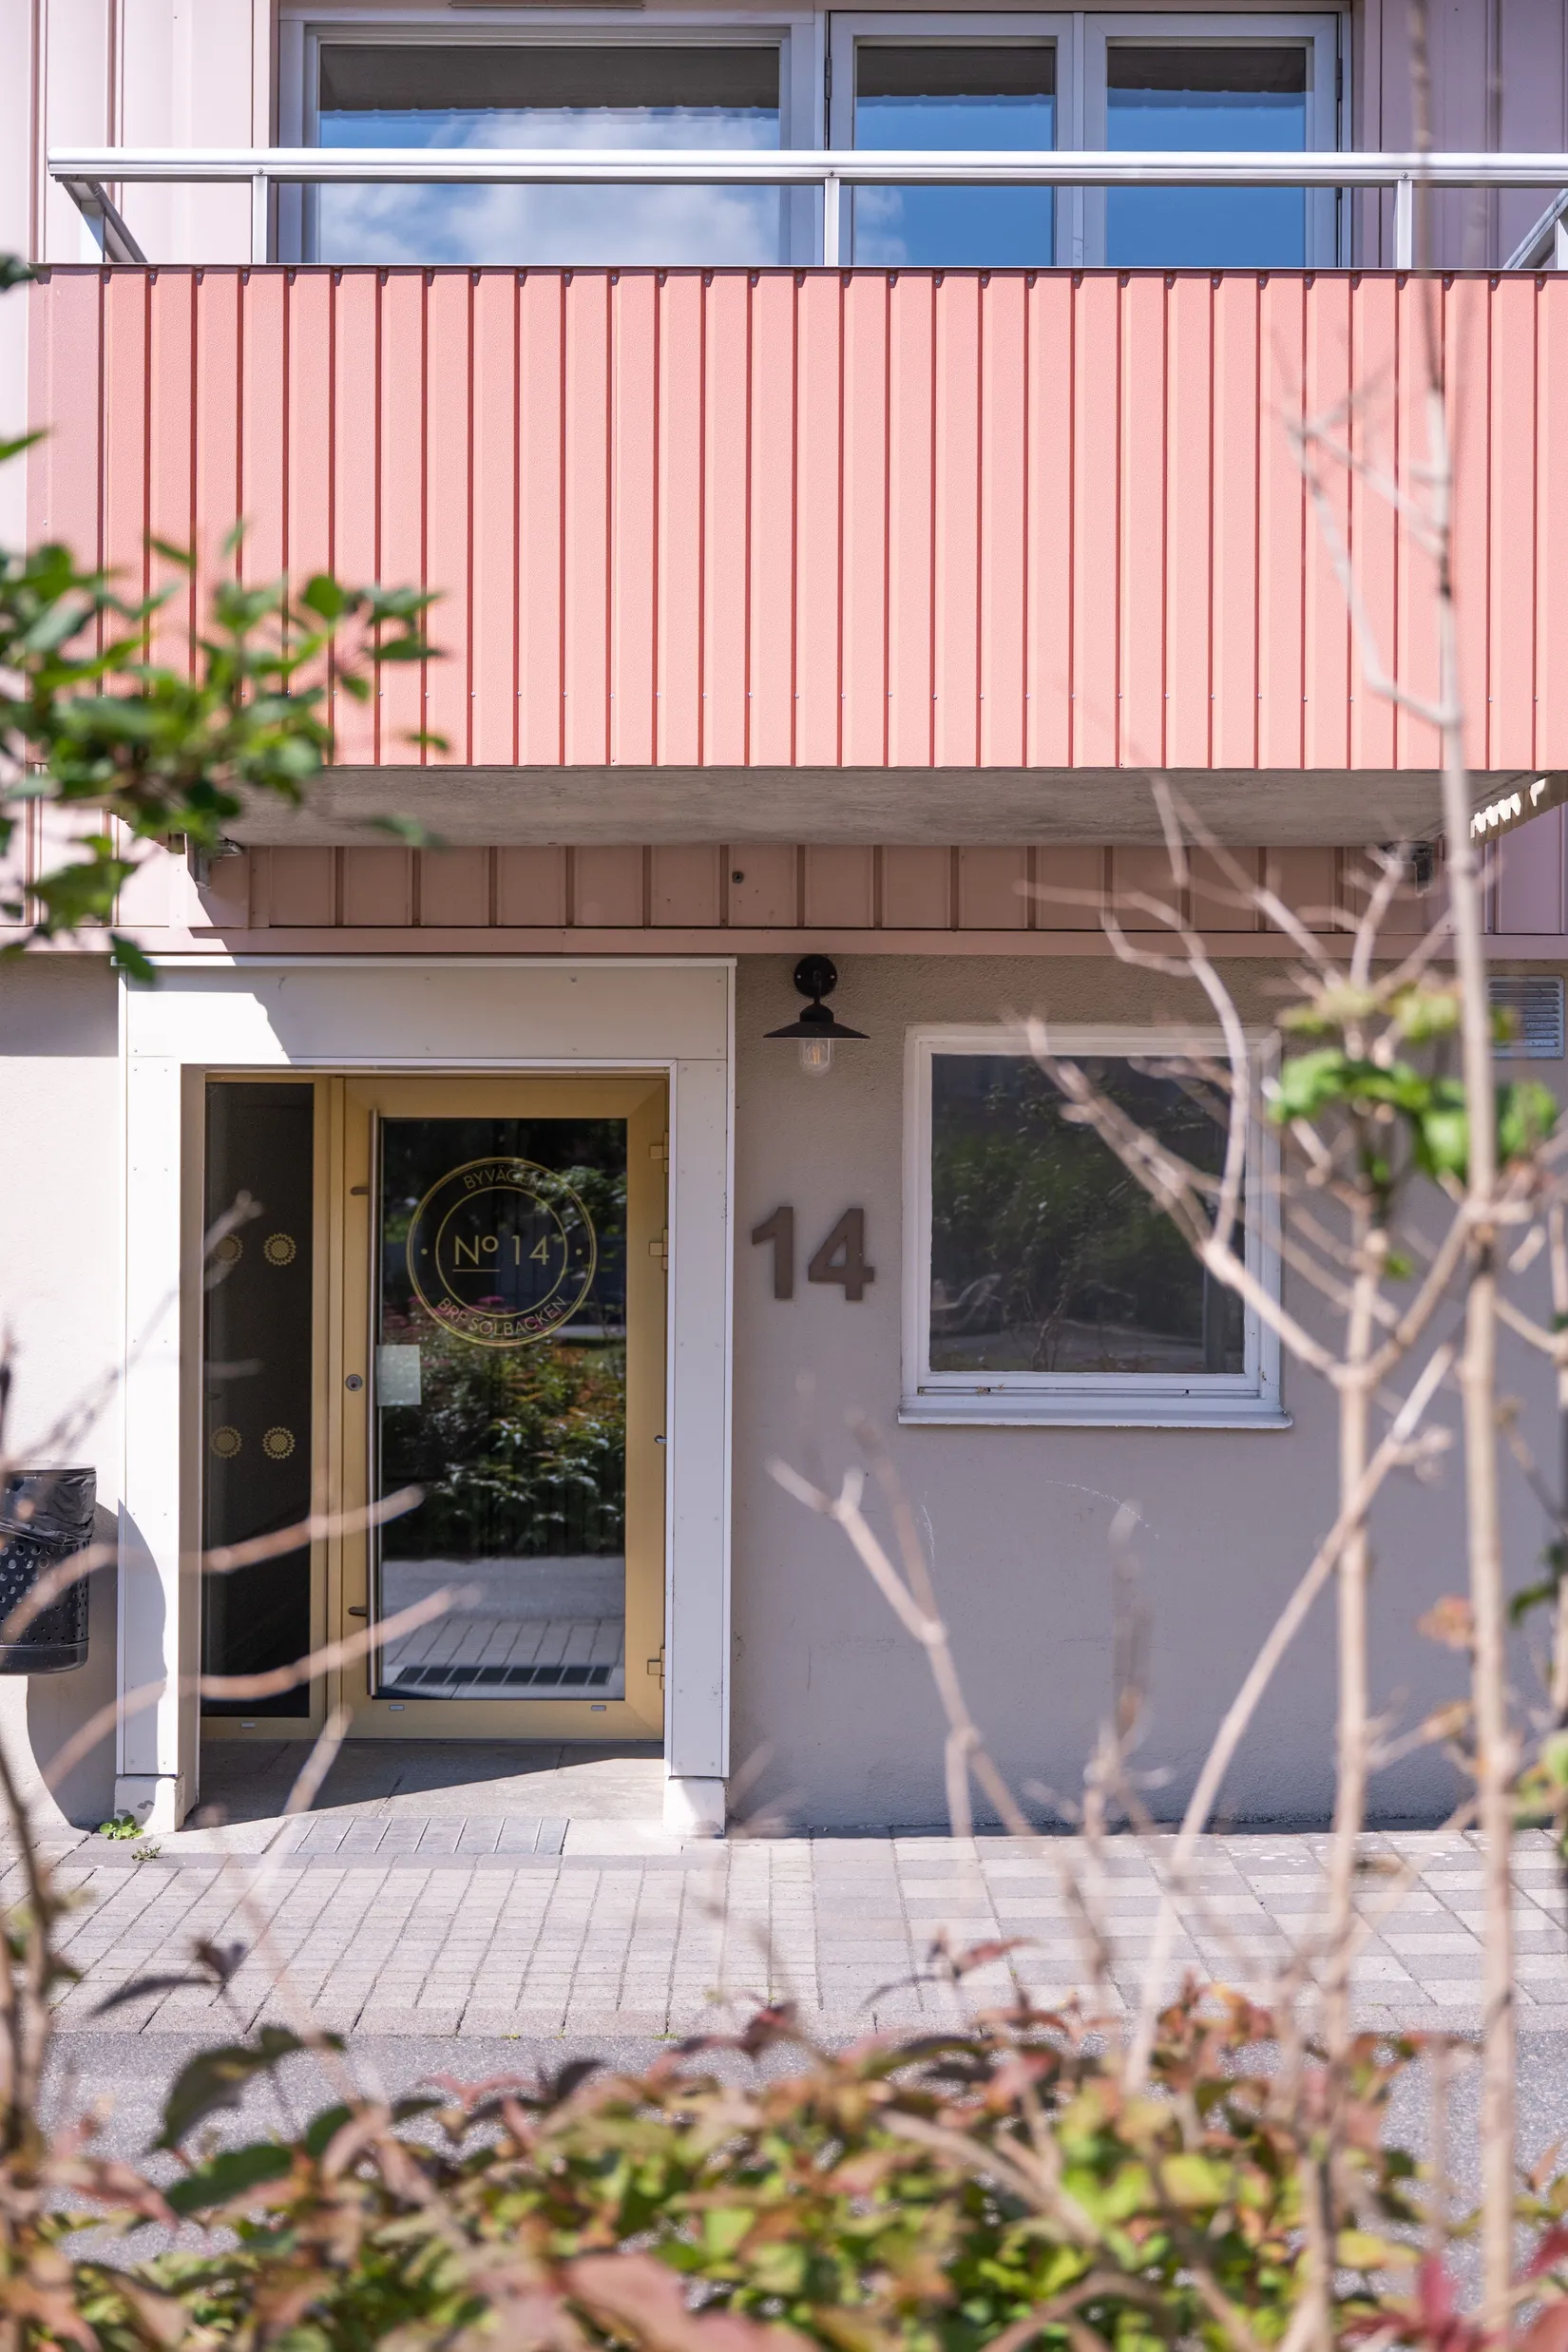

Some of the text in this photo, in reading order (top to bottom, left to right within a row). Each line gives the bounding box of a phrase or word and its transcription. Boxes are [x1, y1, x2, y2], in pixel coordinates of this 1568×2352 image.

[511, 1234, 550, 1266] 14
[751, 1206, 875, 1301] 14
[437, 1295, 567, 1336] BRF SOLBACKEN
